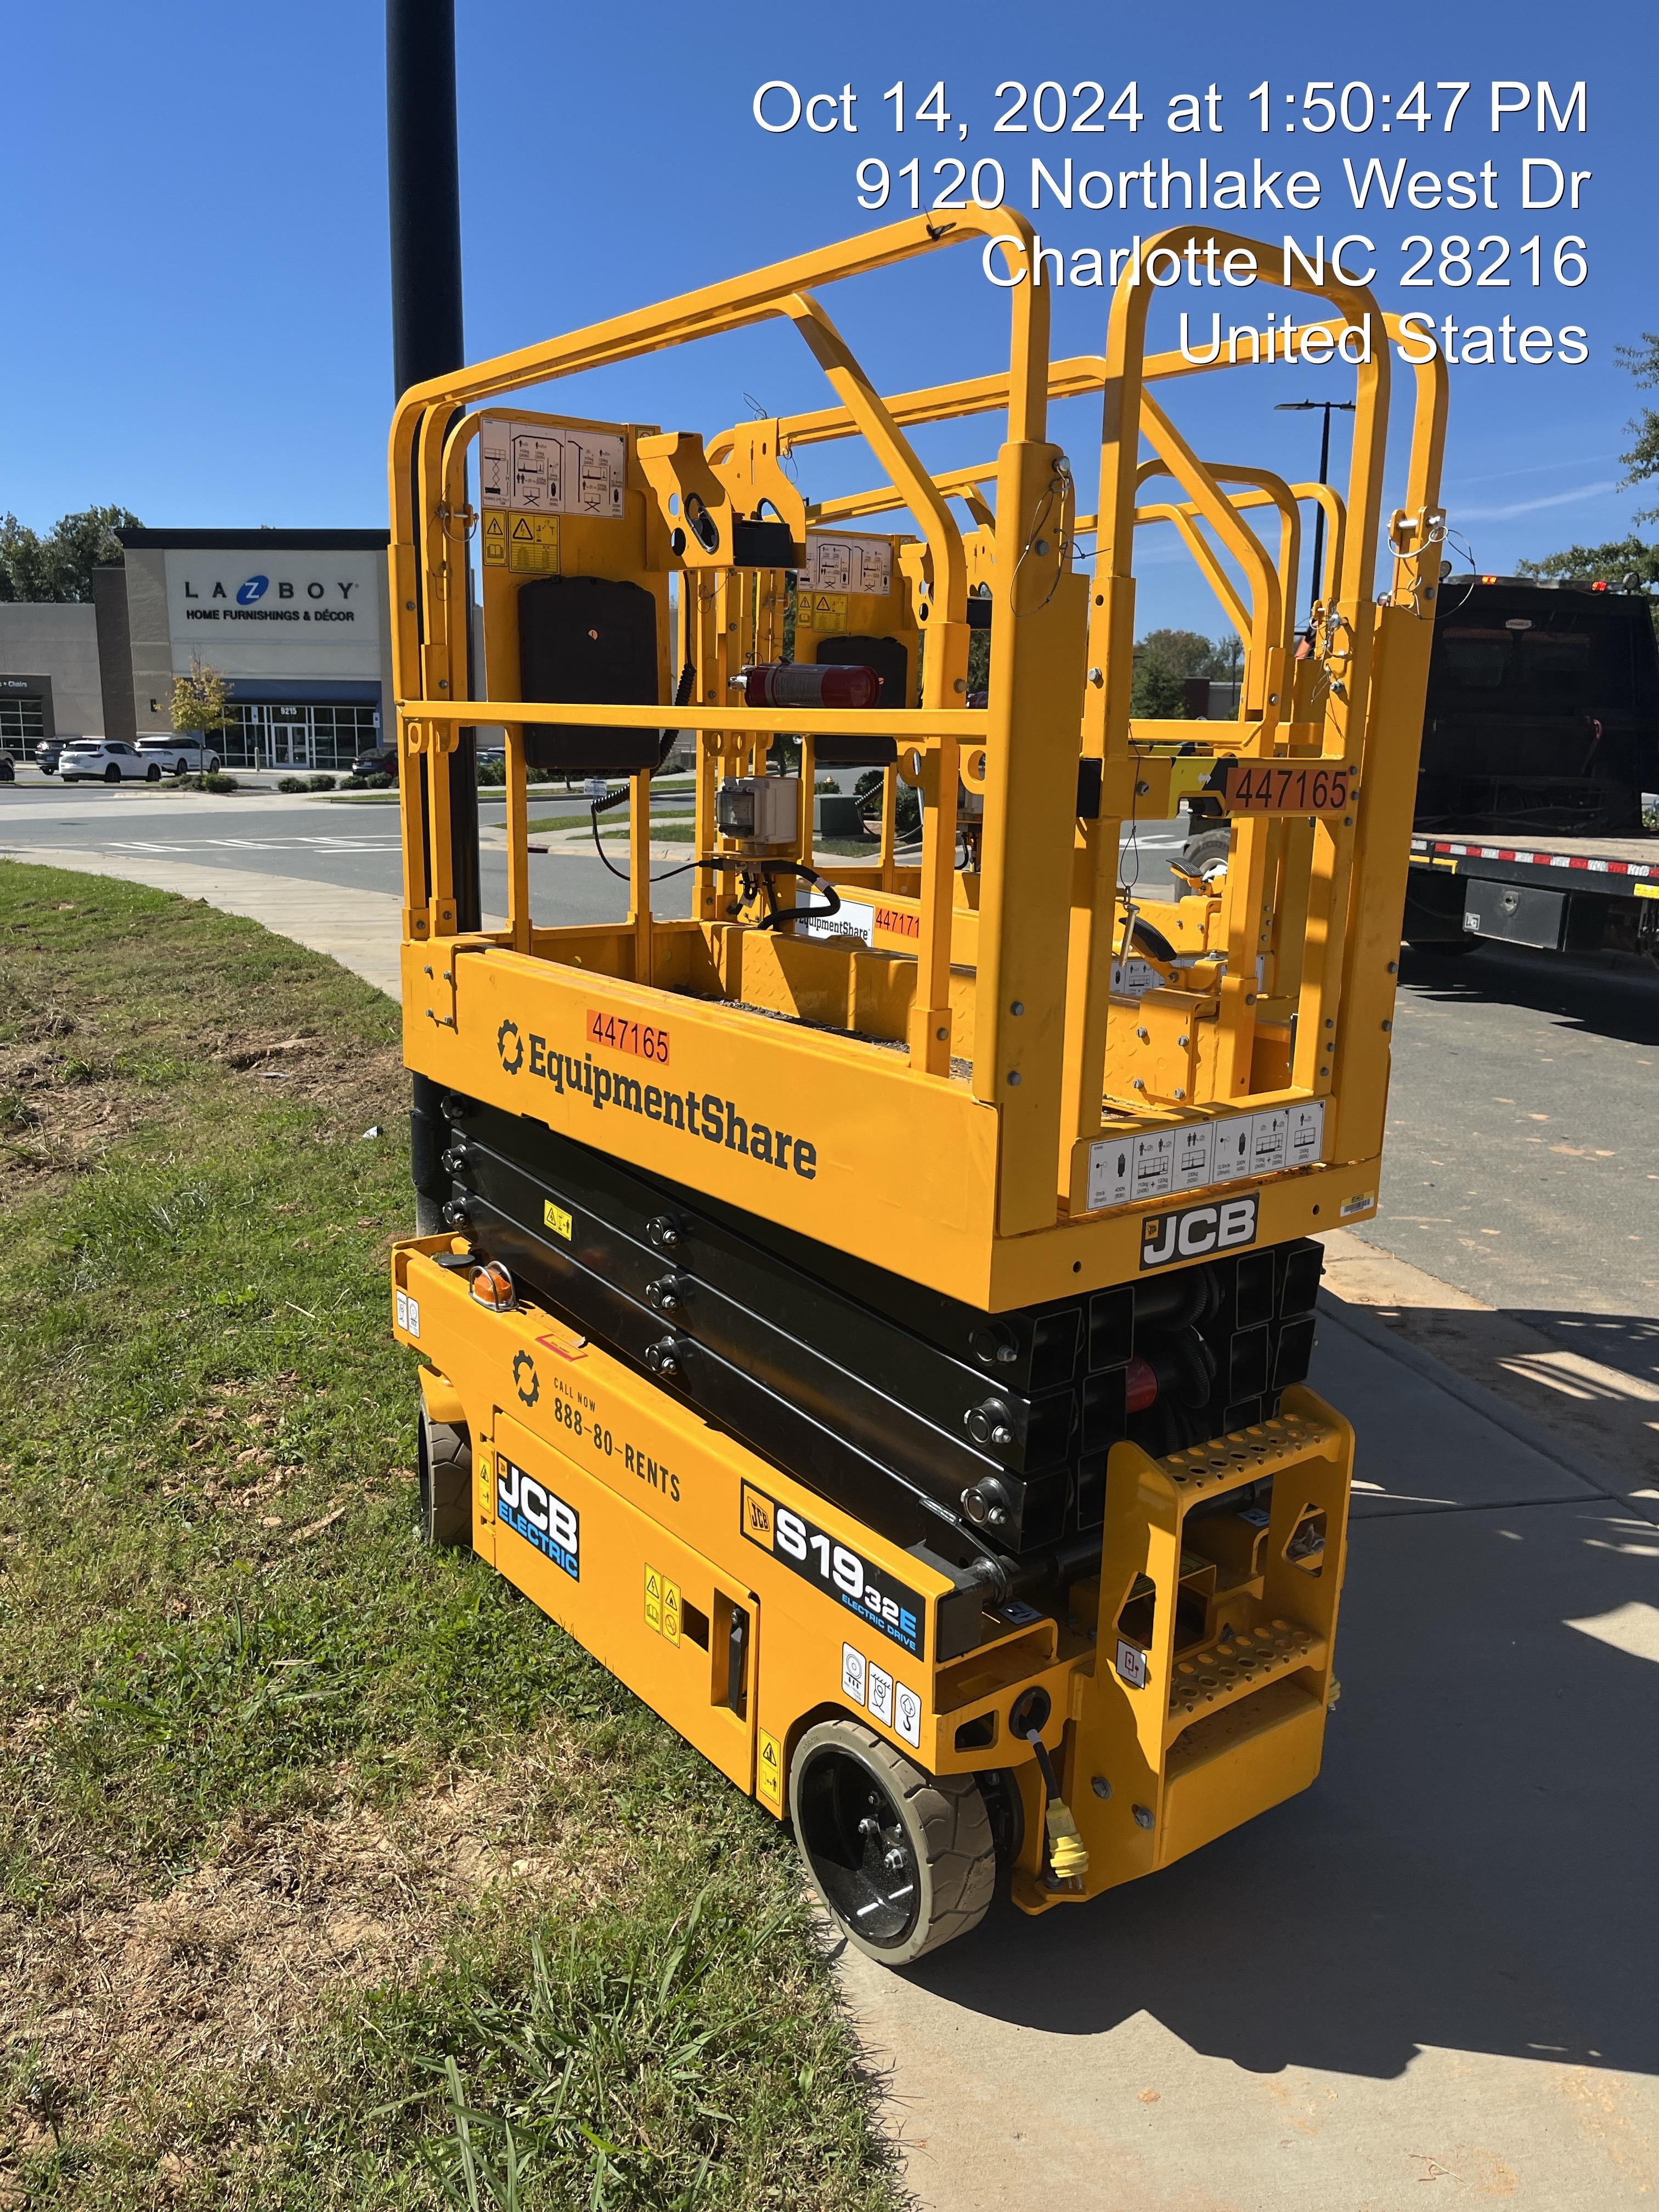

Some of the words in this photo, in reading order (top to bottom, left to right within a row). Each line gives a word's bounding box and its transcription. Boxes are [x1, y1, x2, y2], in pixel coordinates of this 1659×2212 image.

[186, 610, 220, 620] HOME
[223, 610, 300, 620] FURNISHINGS
[303, 611, 311, 621] &
[314, 608, 355, 621] DÉCOR
[280, 707, 297, 715] 9215
[1235, 769, 1347, 808] 447165
[876, 909, 919, 939] 447171
[592, 1013, 669, 1063] 447165
[528, 1032, 817, 1181] EquipmentShare
[1143, 1199, 1255, 1264] JCB
[554, 1377, 573, 1399] CALL
[577, 1392, 596, 1413] NOW
[554, 1397, 680, 1503] 888-80-RENTS
[498, 1466, 578, 1555] JCB
[751, 1502, 769, 1530] JCB
[498, 1499, 578, 1578] ELECTRIC
[842, 1593, 885, 1629] ELECTRIC
[887, 1624, 916, 1651] DRIVE
